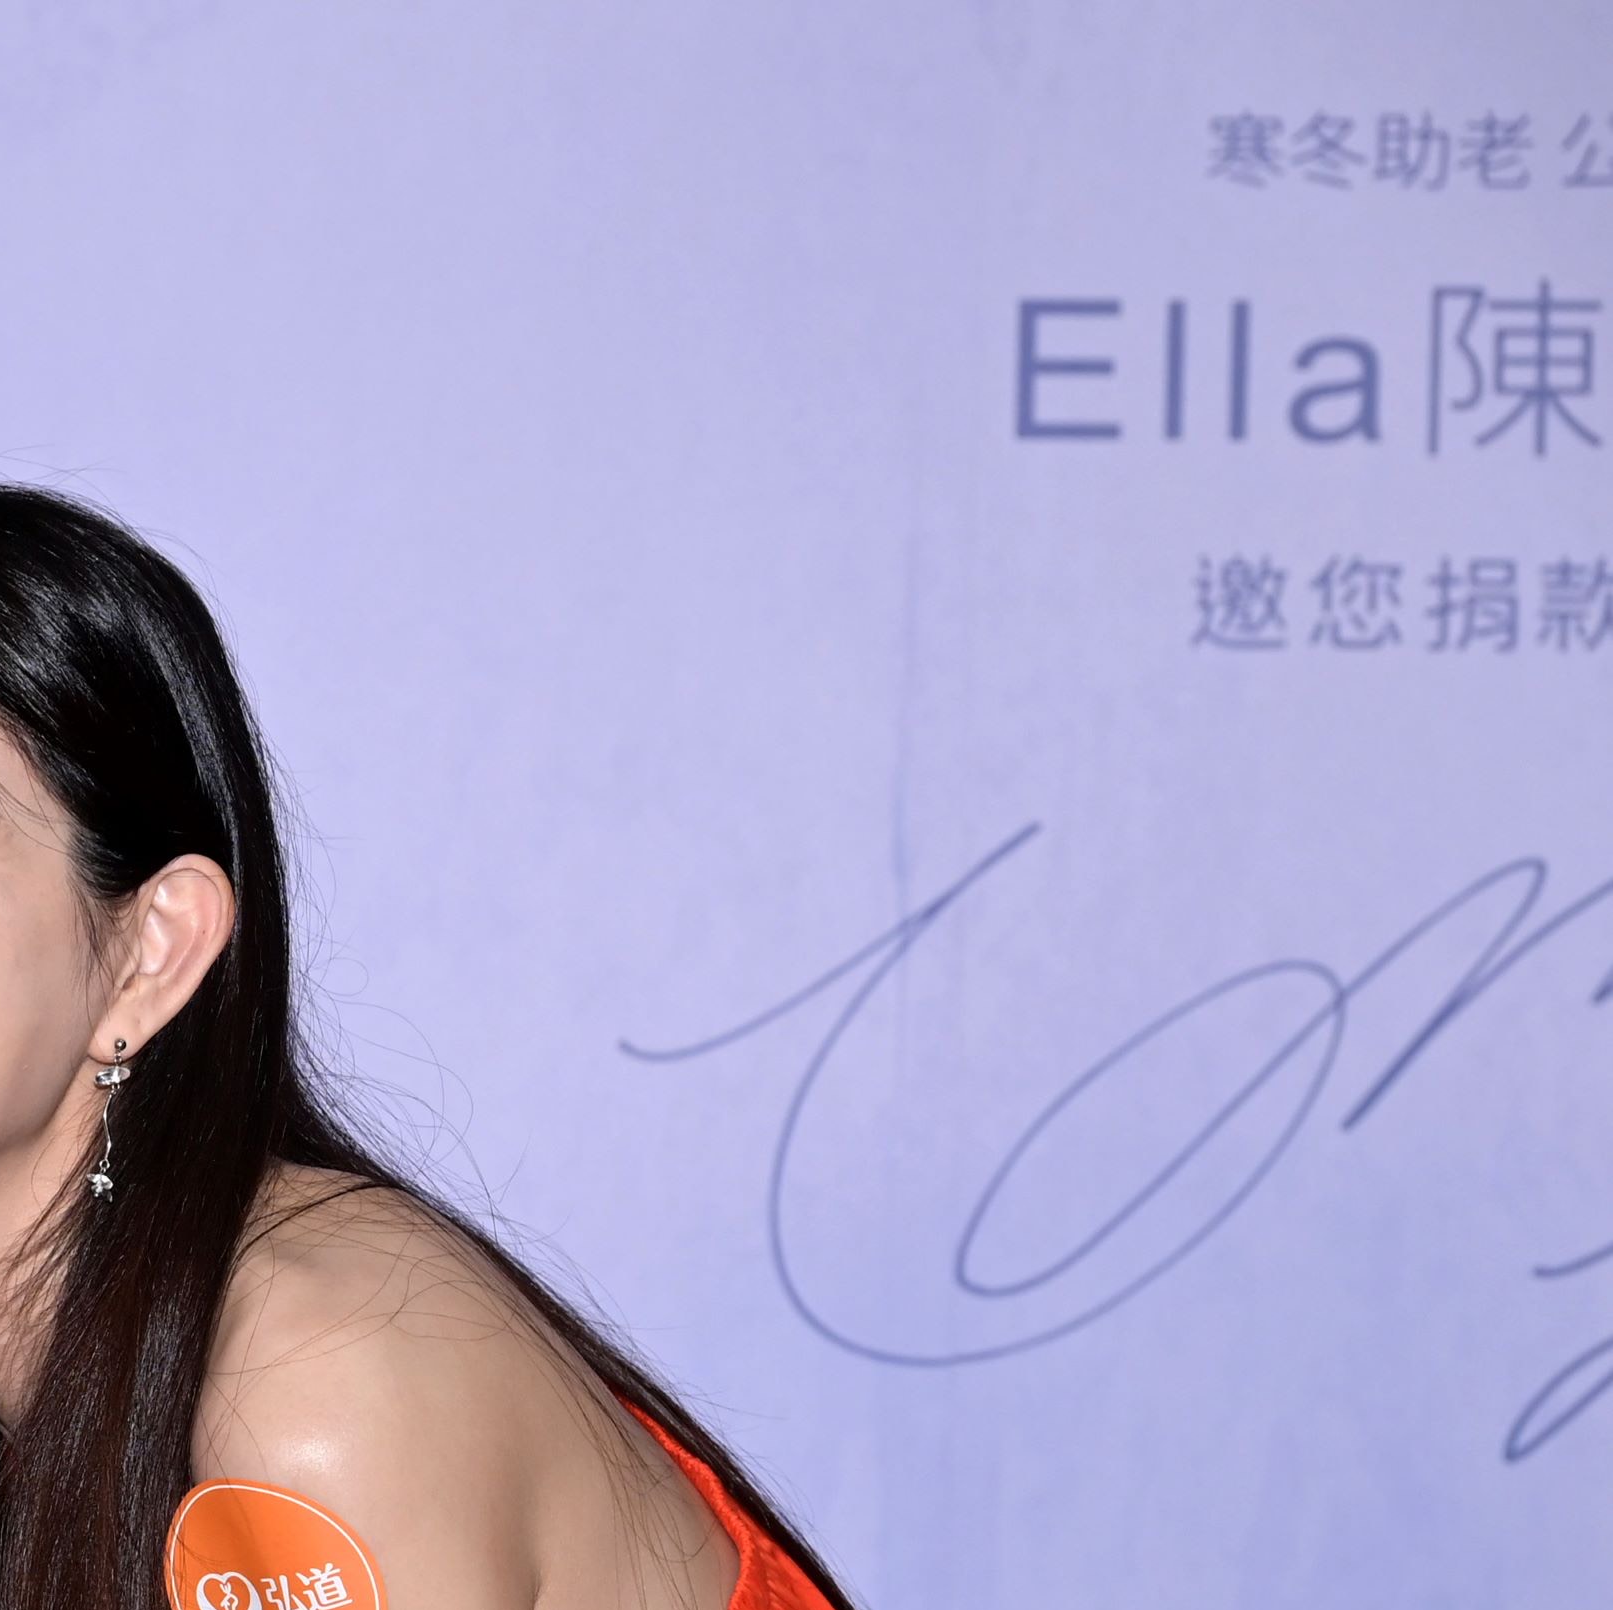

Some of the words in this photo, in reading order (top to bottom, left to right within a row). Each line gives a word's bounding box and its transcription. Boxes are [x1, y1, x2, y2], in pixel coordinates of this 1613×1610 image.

[1205, 108, 1534, 192] 寒冬助老
[1189, 552, 1613, 655] 邀您捐款
